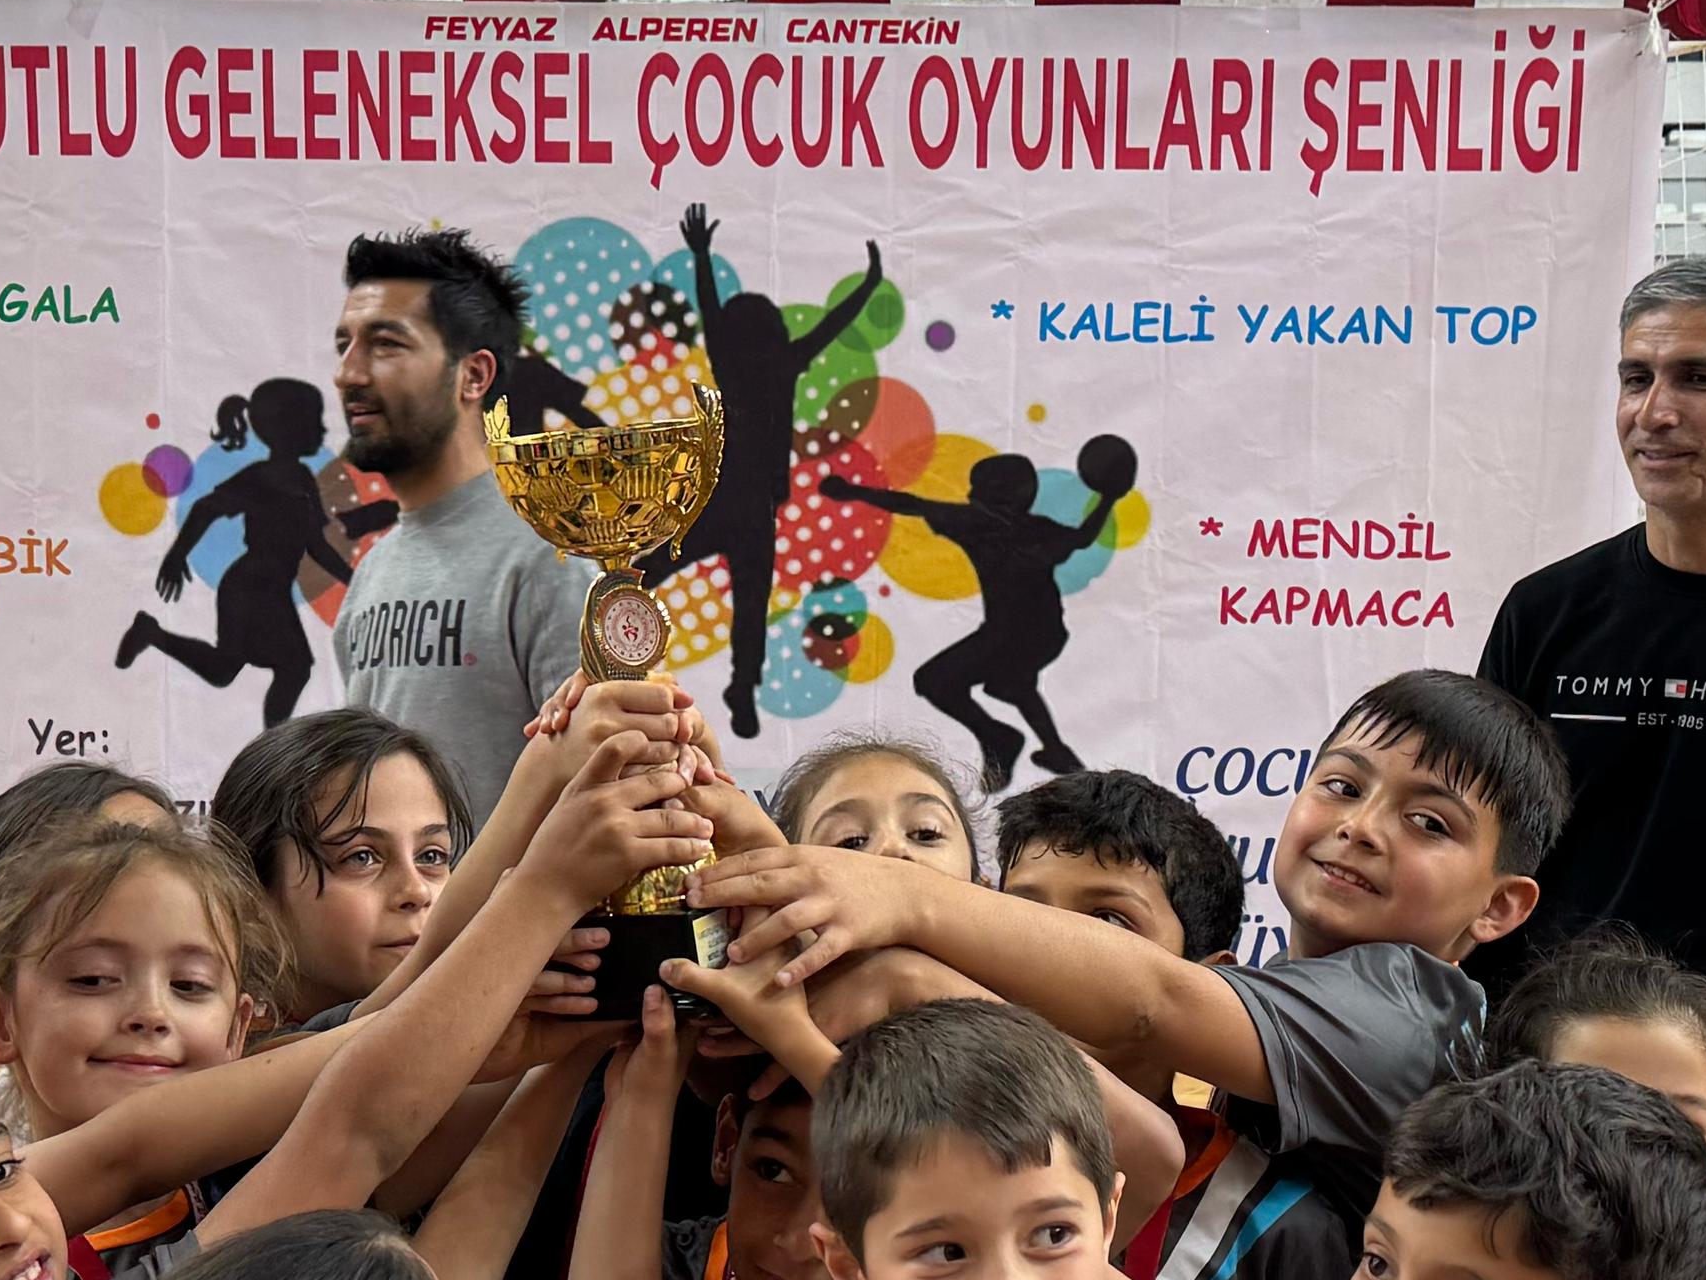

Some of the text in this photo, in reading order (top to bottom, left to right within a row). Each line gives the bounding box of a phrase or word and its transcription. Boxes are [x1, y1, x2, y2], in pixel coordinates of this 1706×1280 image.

[424, 16, 961, 46] FEYYAZ ALPEREN CANTEKİN
[164, 47, 613, 165] GELENEKSEL
[636, 51, 886, 189] ÇOCUK
[908, 56, 1274, 173] OYUNLARI
[1300, 26, 1586, 197] ŞENLİĞİ
[1036, 294, 1537, 348] KALELİ YAKAN TOP
[1246, 511, 1452, 561] MENDİL
[1219, 584, 1455, 629] KAPMACA
[1556, 675, 1653, 697] TOMMY
[27, 717, 110, 757] Yer:
